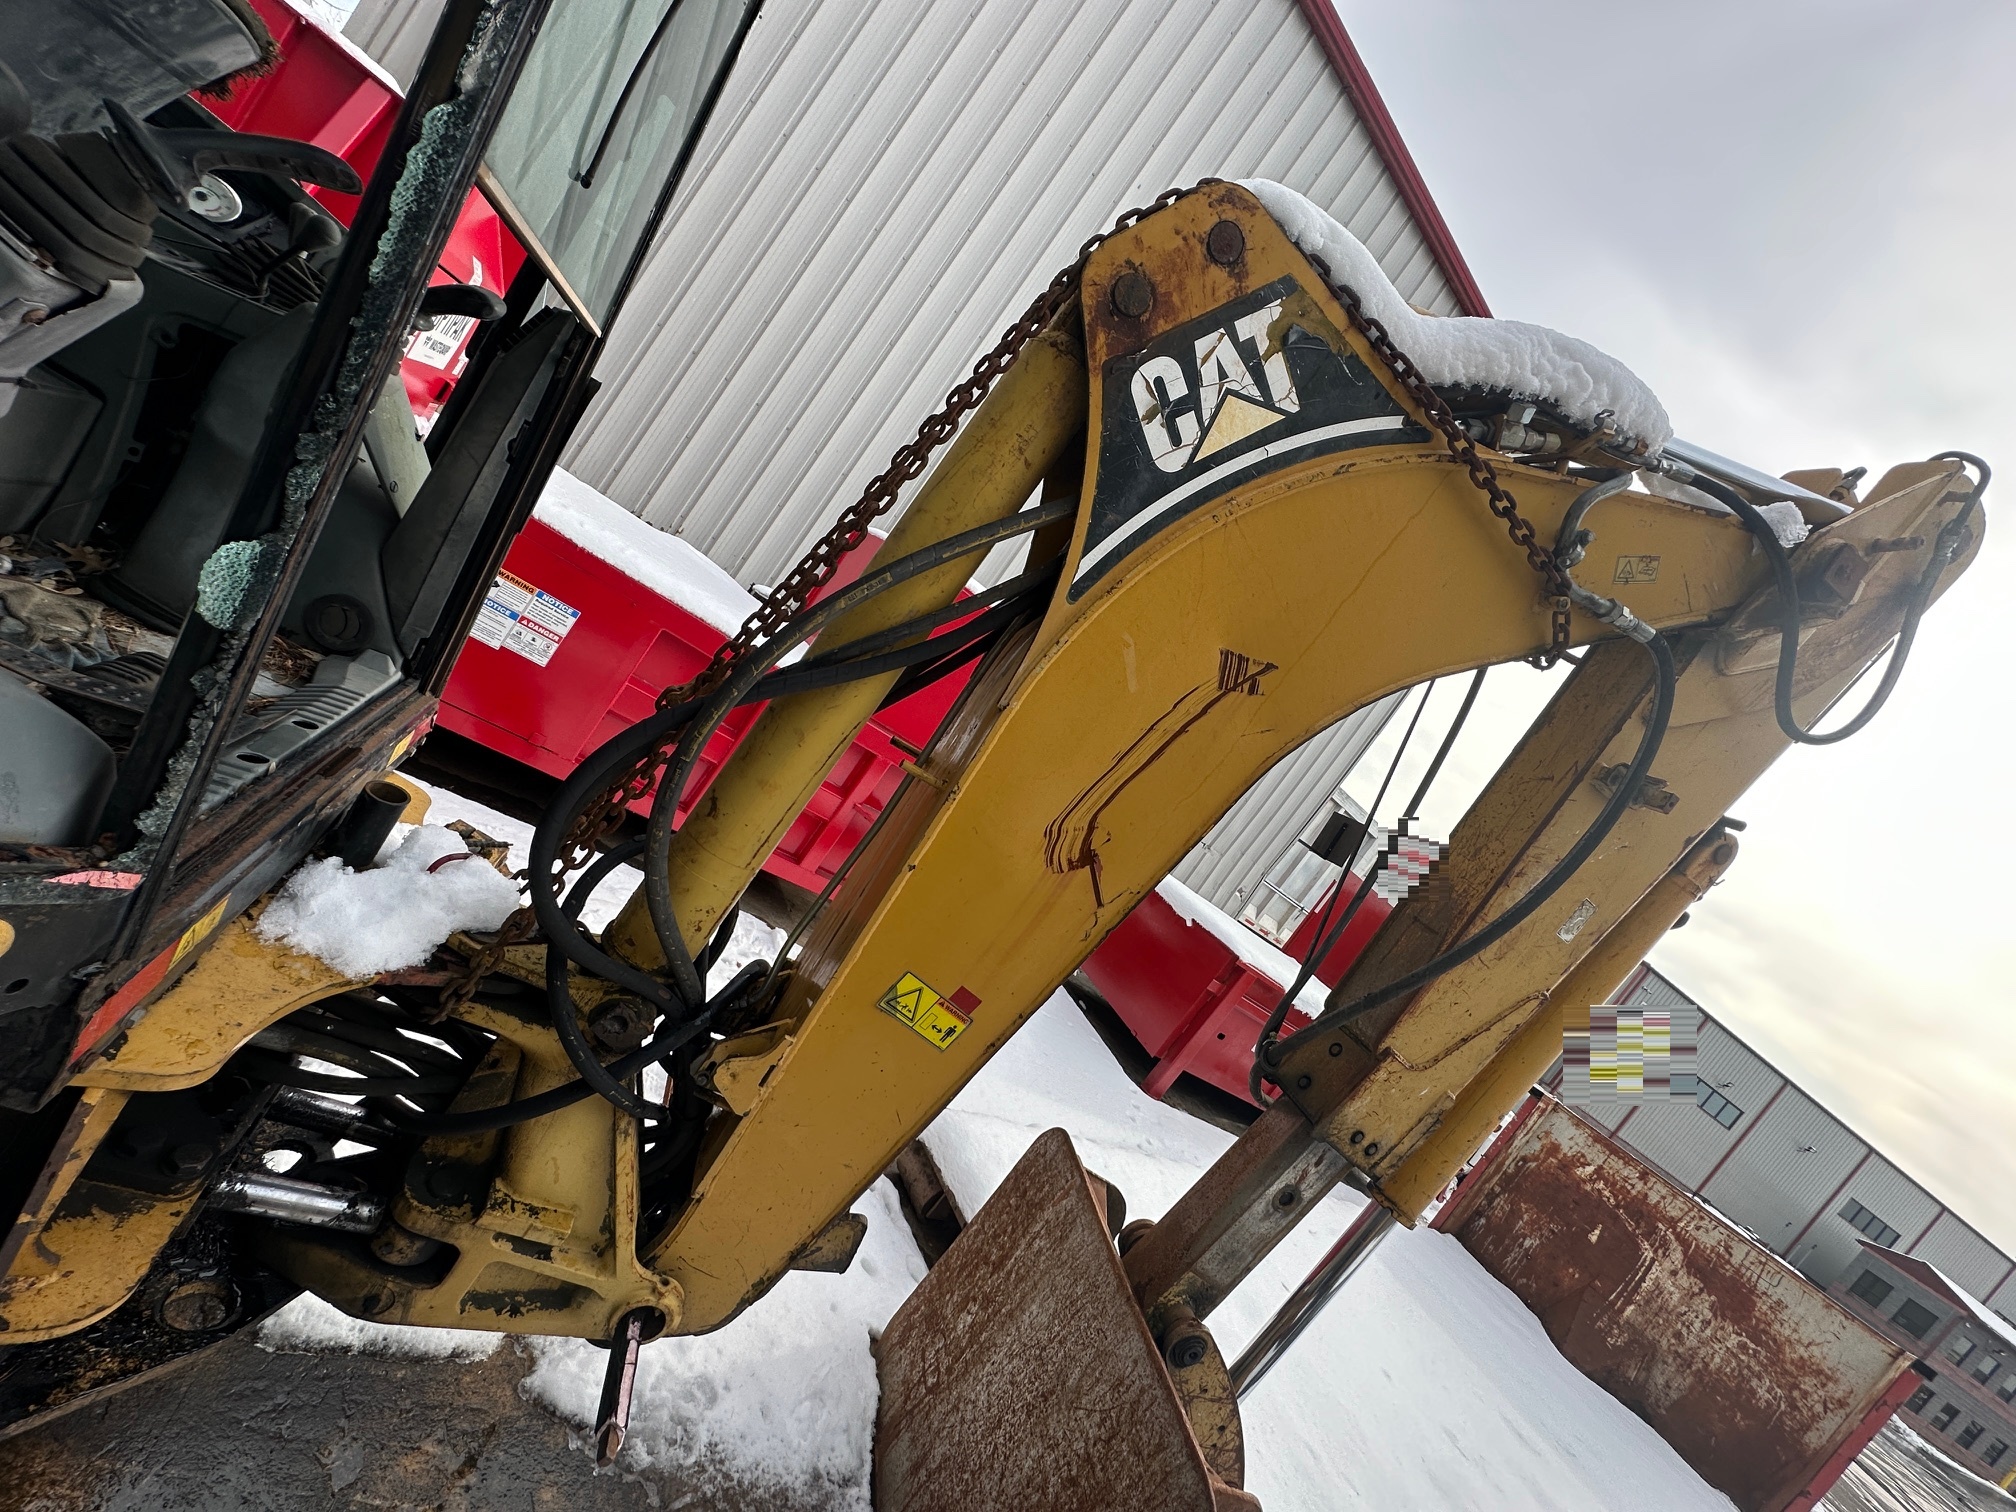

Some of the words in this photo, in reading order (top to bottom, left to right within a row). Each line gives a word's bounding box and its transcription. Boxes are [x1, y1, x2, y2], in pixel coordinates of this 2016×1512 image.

[1130, 297, 1301, 473] CAT
[498, 570, 535, 594] WARNING
[541, 594, 574, 616] NOTICE
[527, 621, 560, 642] DANGER
[945, 1004, 969, 1025] WARNING
